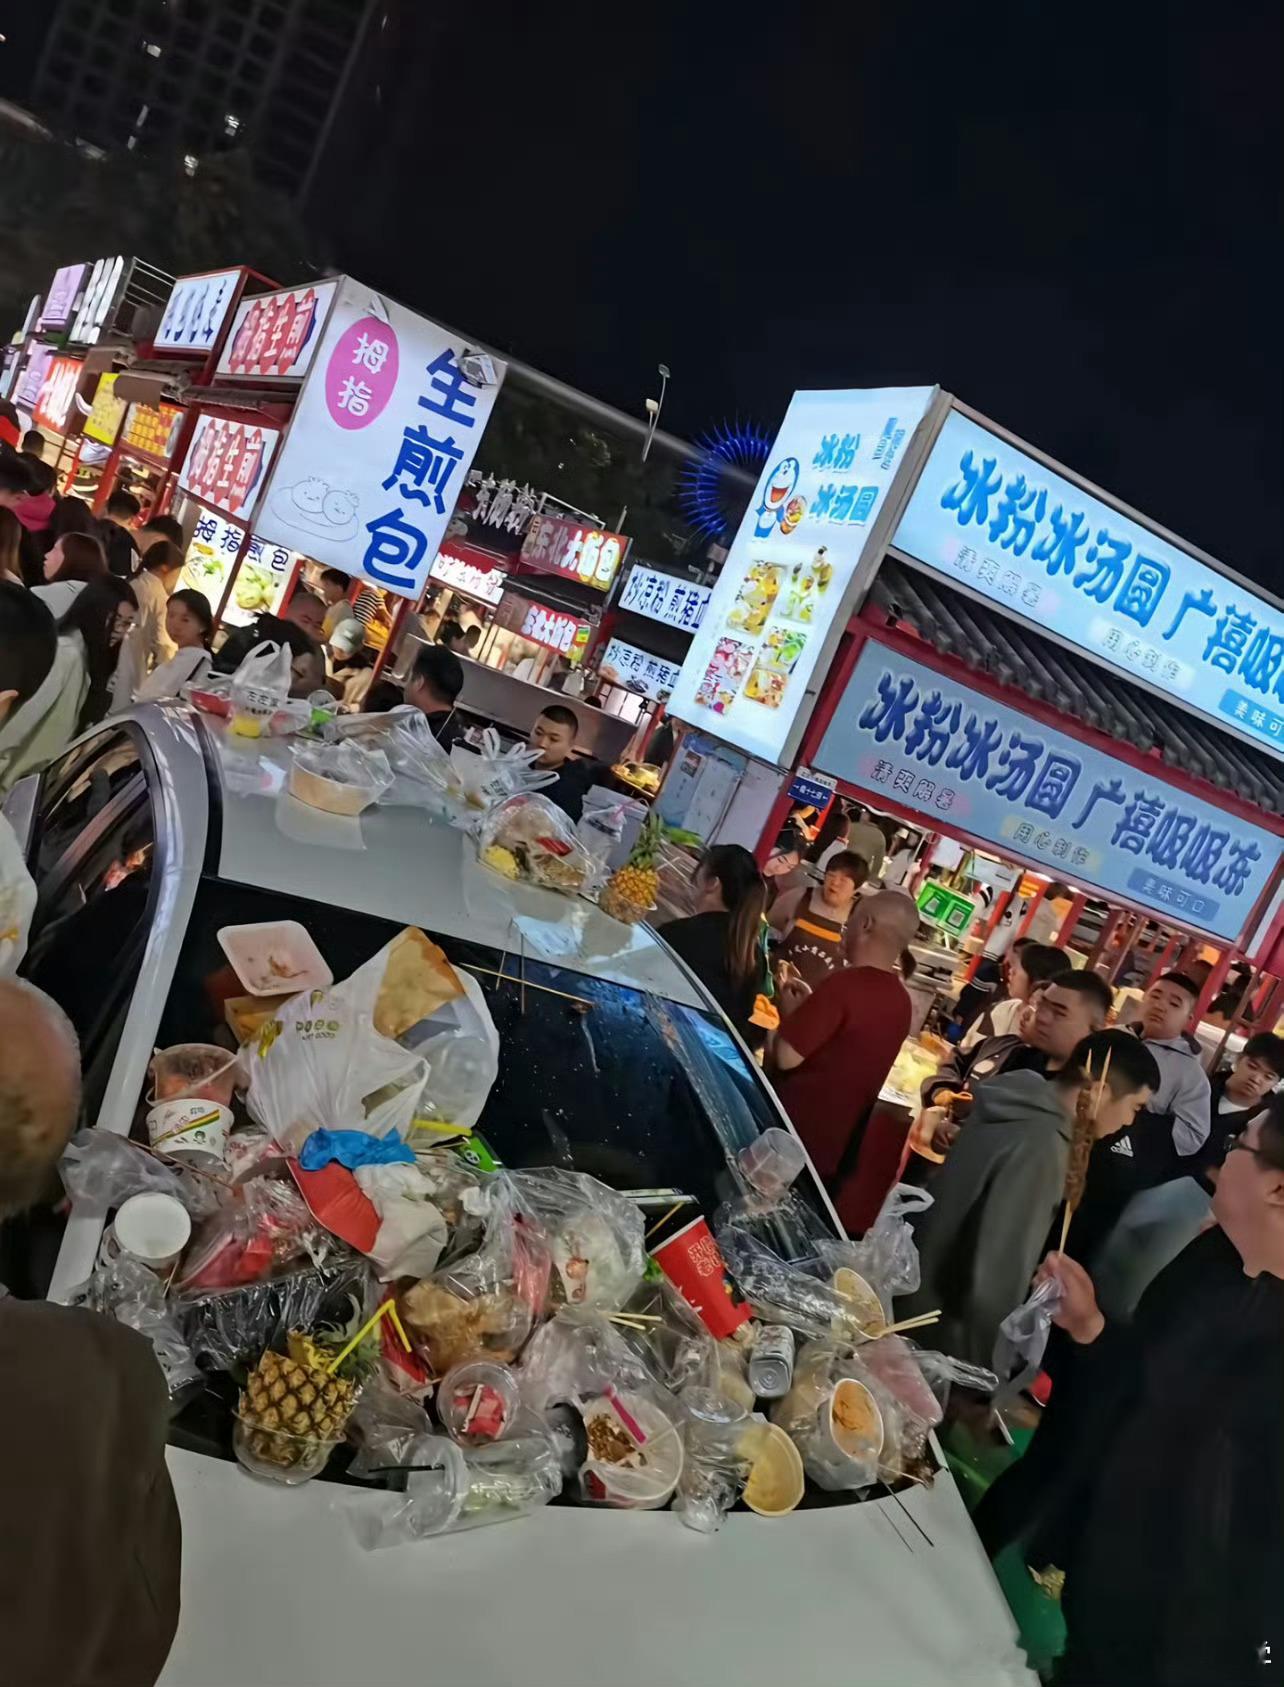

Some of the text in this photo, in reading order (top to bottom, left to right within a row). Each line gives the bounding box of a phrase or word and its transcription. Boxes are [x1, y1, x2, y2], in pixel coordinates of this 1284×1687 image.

[336, 331, 389, 417] 拇指
[363, 348, 477, 589] 生煎包
[940, 449, 1171, 627] 冰粉冰汤圆
[858, 671, 1084, 820] 冰粉冰汤圆
[870, 758, 955, 811] 清爽解暑
[1012, 821, 1091, 866] 用心制作
[1140, 877, 1207, 915] 美味可口
